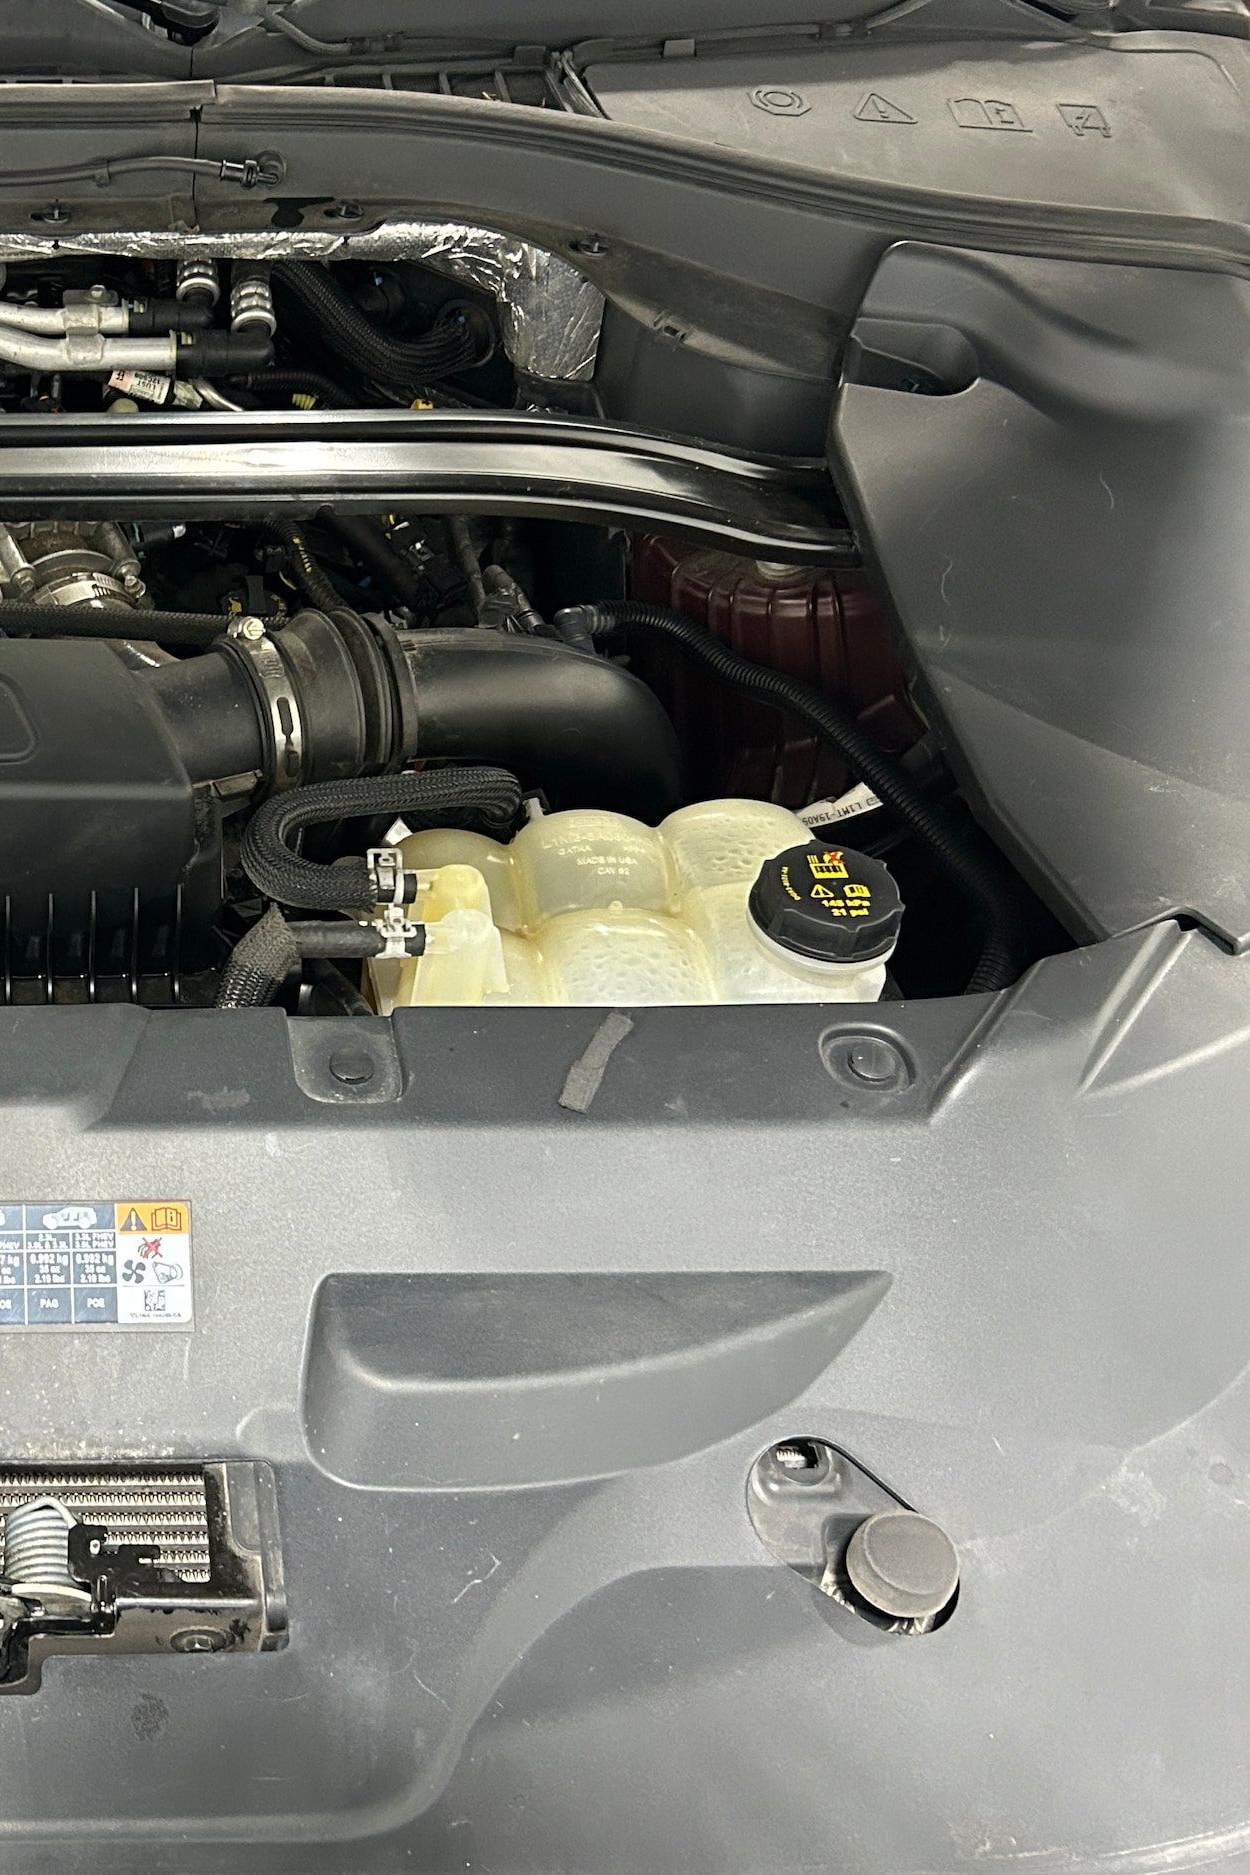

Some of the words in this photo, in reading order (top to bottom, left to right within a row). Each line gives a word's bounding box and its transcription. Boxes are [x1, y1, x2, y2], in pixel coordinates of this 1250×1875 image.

[8, 1254, 20, 1267] kg
[57, 1253, 68, 1265] kg
[102, 1253, 114, 1266] kg
[40, 1298, 59, 1308] PAG
[87, 1297, 105, 1308] POE
